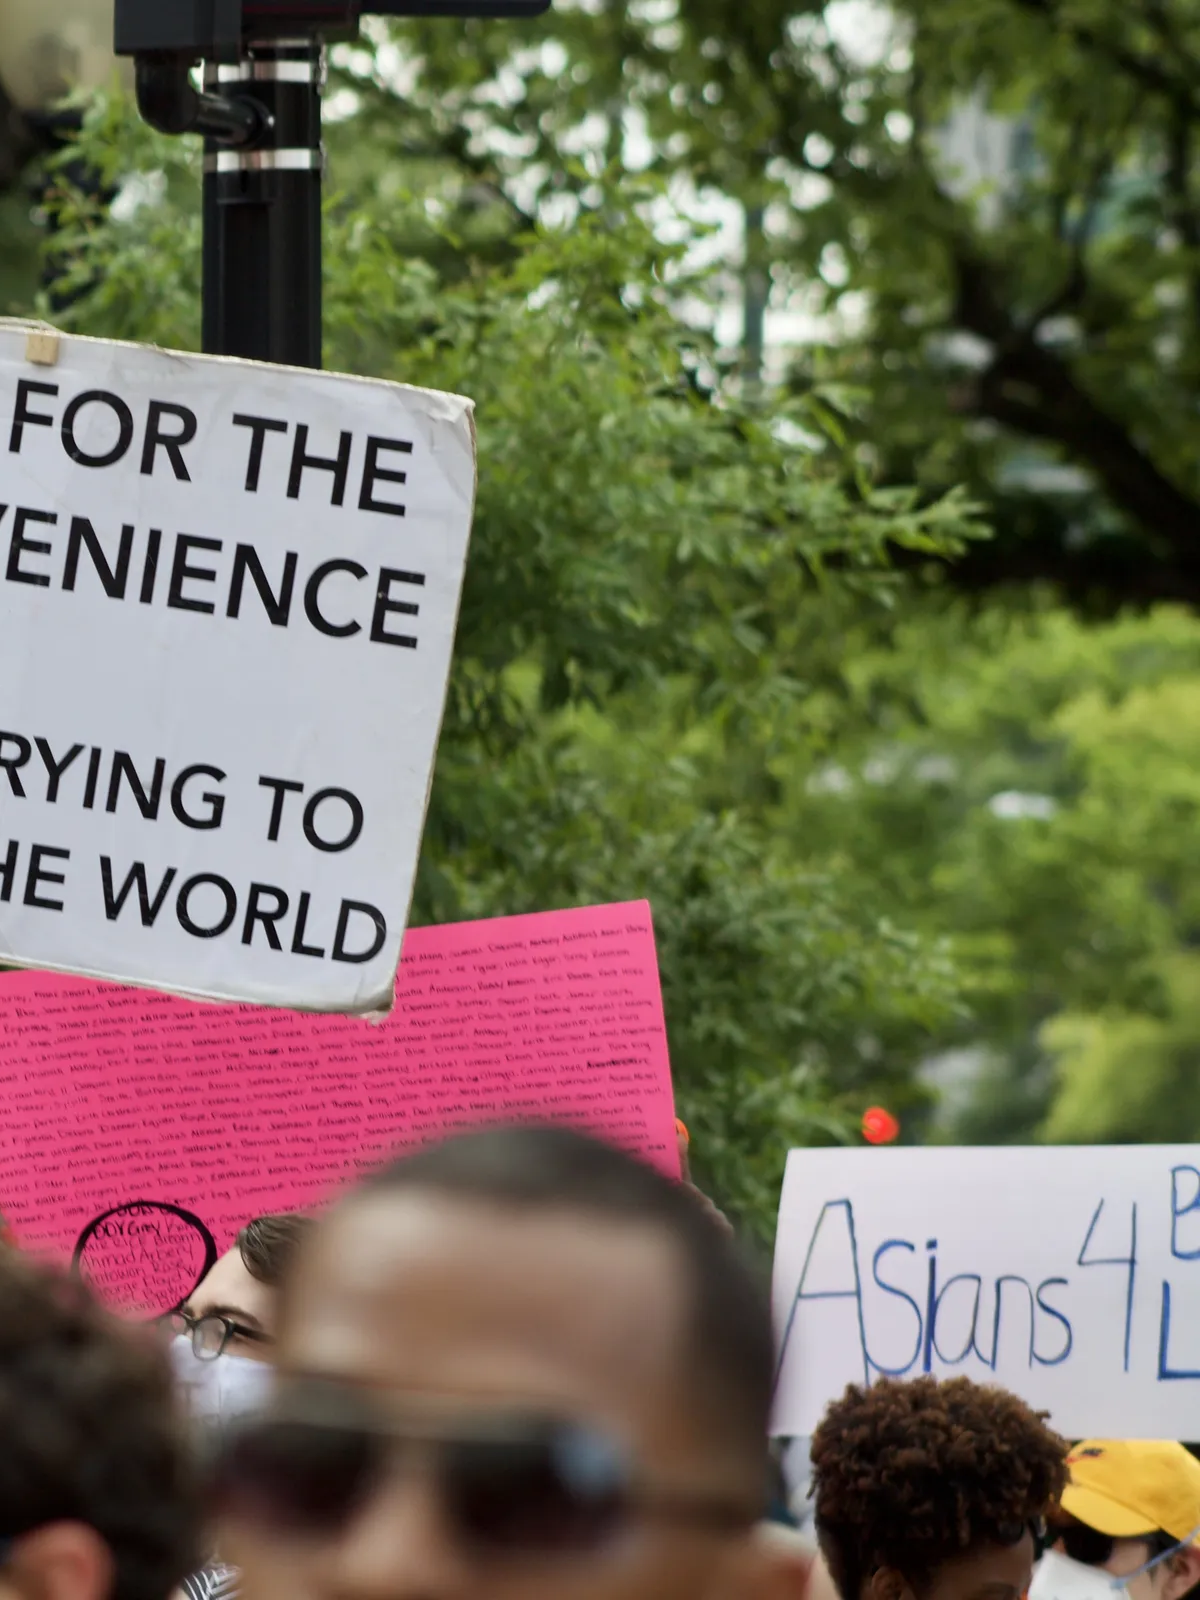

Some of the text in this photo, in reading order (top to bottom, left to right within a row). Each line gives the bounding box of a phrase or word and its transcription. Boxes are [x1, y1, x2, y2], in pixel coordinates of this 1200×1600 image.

[9, 379, 197, 481] FOR
[233, 414, 412, 516] THE
[259, 776, 363, 852] TO
[100, 856, 386, 963] WORLD
[772, 1198, 1138, 1388] Asians 4
